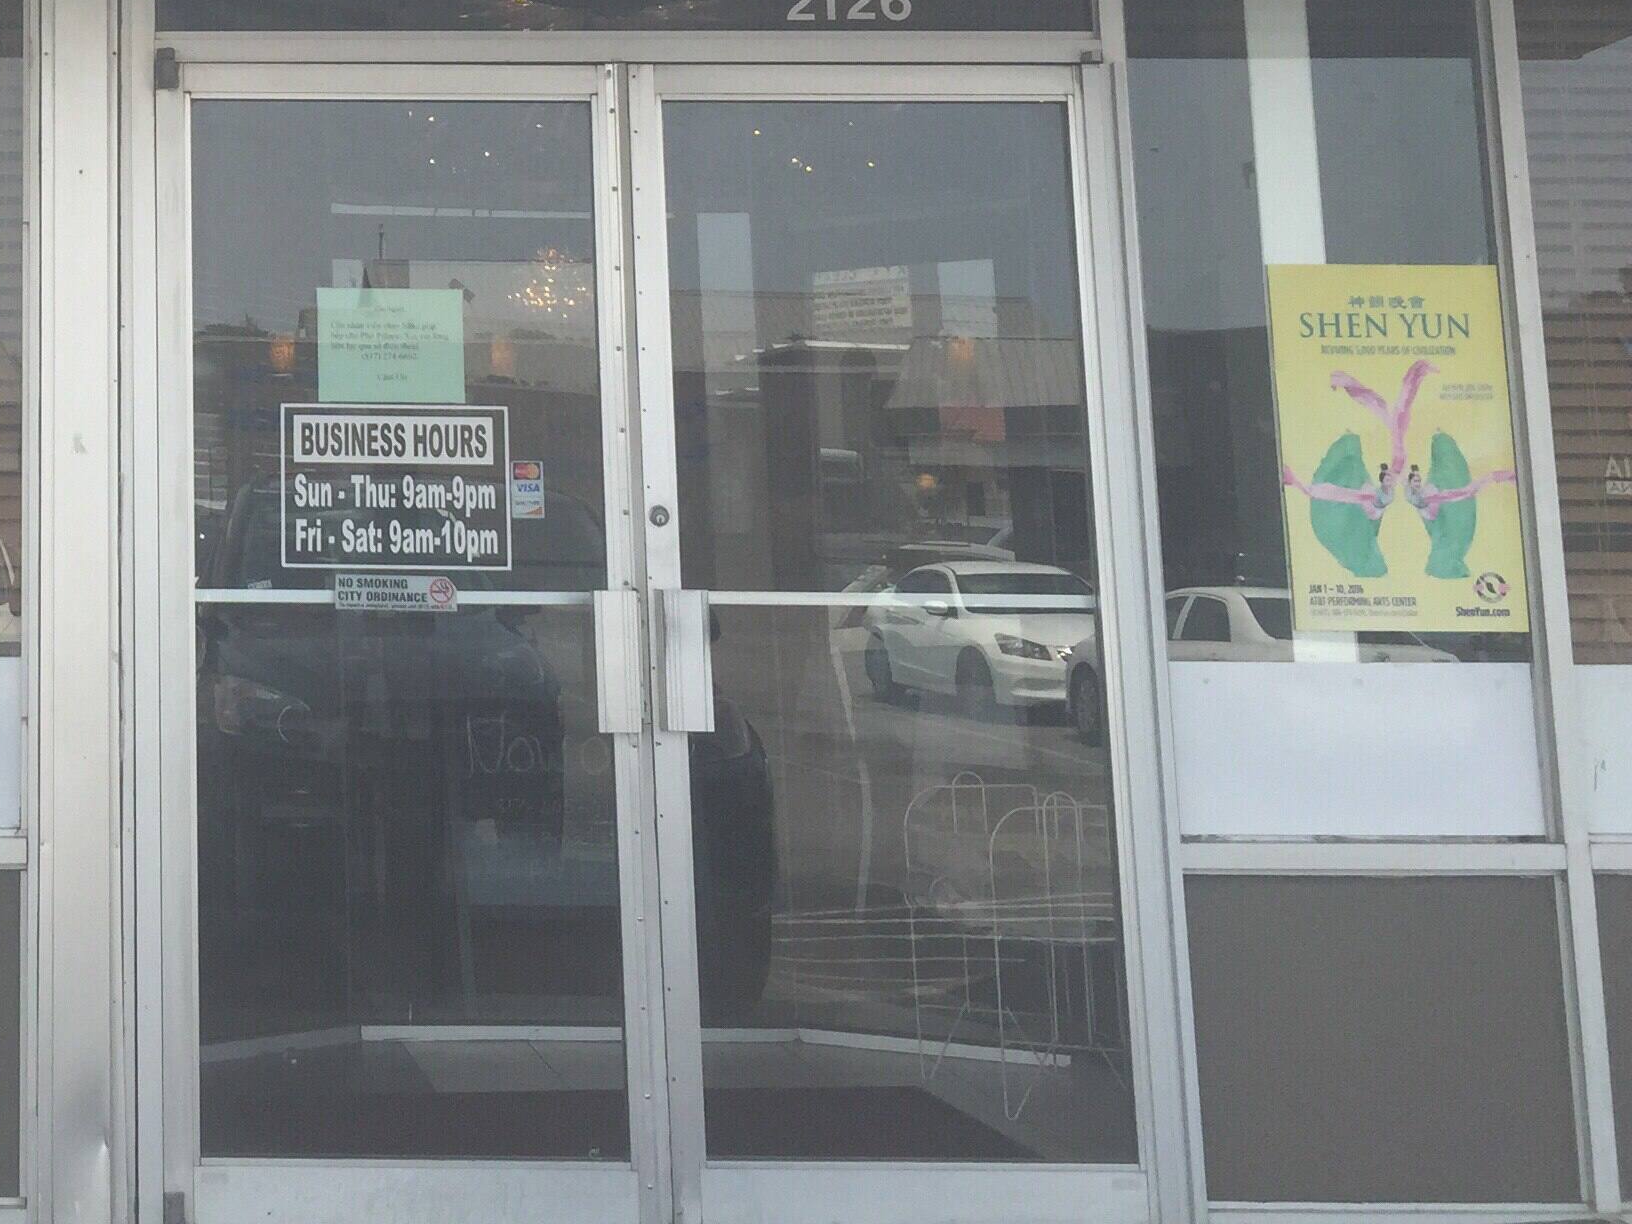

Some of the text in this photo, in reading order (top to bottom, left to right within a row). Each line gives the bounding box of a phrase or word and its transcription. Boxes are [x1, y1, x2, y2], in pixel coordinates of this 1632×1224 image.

[1299, 312, 1471, 338] SHEN YUN
[300, 422, 488, 459] BUSINESS HOURS
[294, 473, 332, 508] Sun
[351, 475, 396, 508] Thu:
[403, 475, 496, 517] 9am-9pm
[516, 483, 541, 493] VISA
[295, 519, 322, 552] Fri
[342, 519, 383, 554] Sat:
[389, 520, 499, 562] 9am-10pm
[338, 578, 409, 589] NO SMOKING
[337, 590, 429, 603] CITY ORDINANCE
[1455, 606, 1511, 617] ShenYun.com
